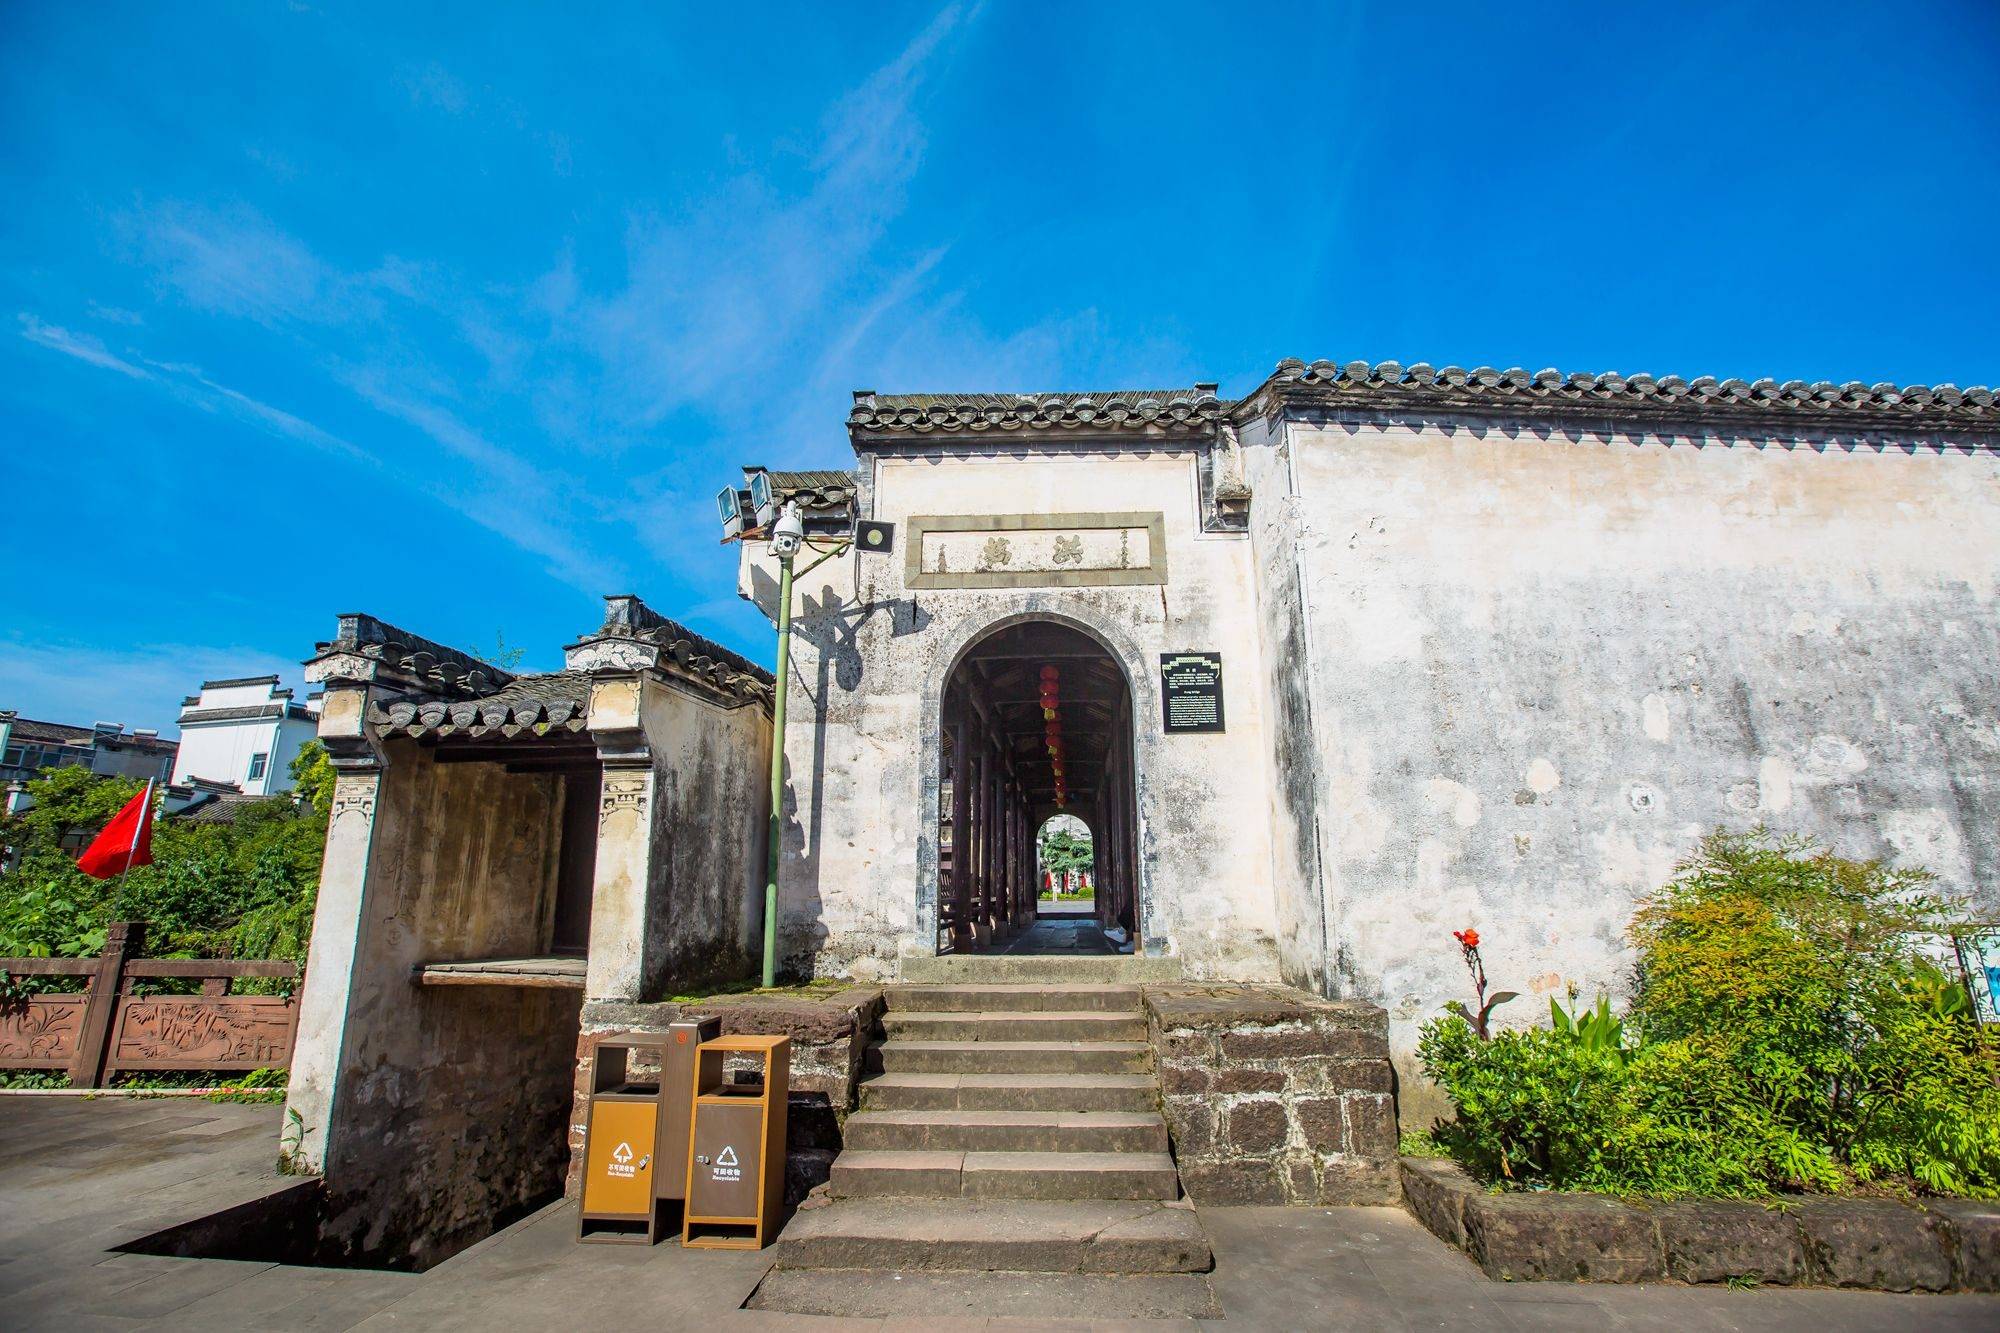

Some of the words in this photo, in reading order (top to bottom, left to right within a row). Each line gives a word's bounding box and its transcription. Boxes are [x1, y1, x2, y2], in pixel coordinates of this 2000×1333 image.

[608, 1163, 635, 1173] 不可回收物
[713, 1167, 741, 1176] 可回收物
